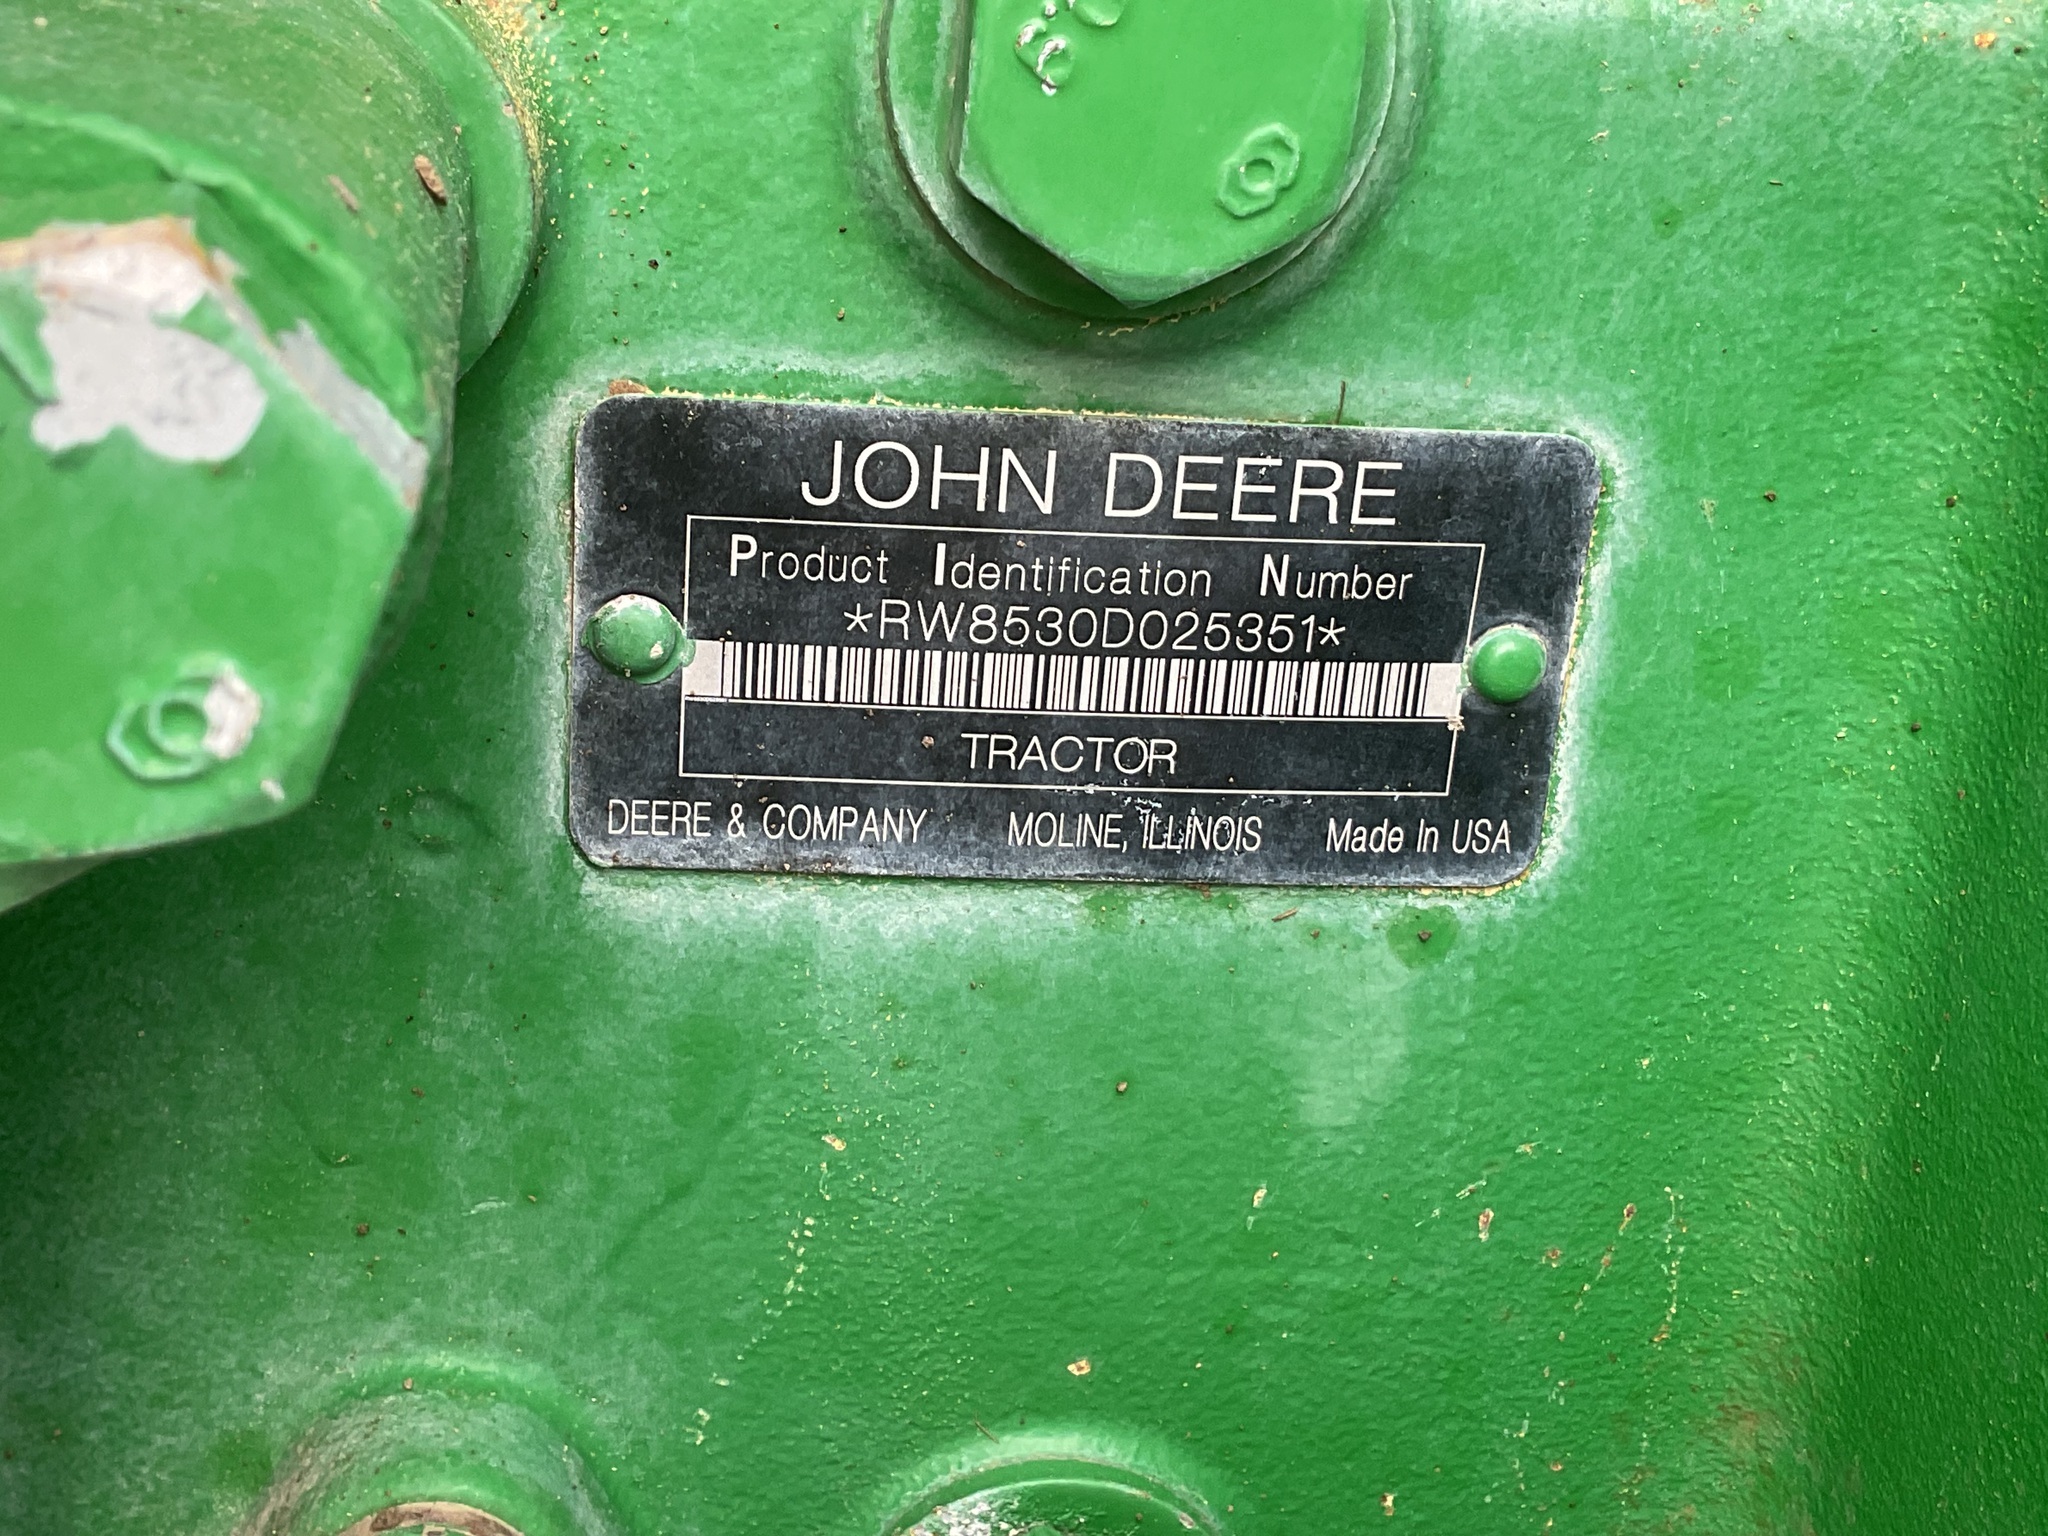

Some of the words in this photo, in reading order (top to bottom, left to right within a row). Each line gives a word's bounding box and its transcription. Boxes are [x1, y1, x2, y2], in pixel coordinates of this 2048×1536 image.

[802, 441, 1056, 515] JOHN
[1105, 453, 1402, 526] DEERE
[731, 534, 888, 584] Product
[935, 543, 1213, 597] Identification
[1261, 554, 1412, 600] Number
[961, 734, 1177, 775] TRACTOR
[608, 799, 711, 837] DEERE
[726, 804, 748, 837] &
[762, 805, 928, 843] COMPANY
[1008, 812, 1128, 853] MOLINE,
[1141, 813, 1263, 853] ILLINOIS
[1326, 818, 1403, 854] Made
[1417, 819, 1439, 853] In
[1453, 819, 1511, 855] USA
